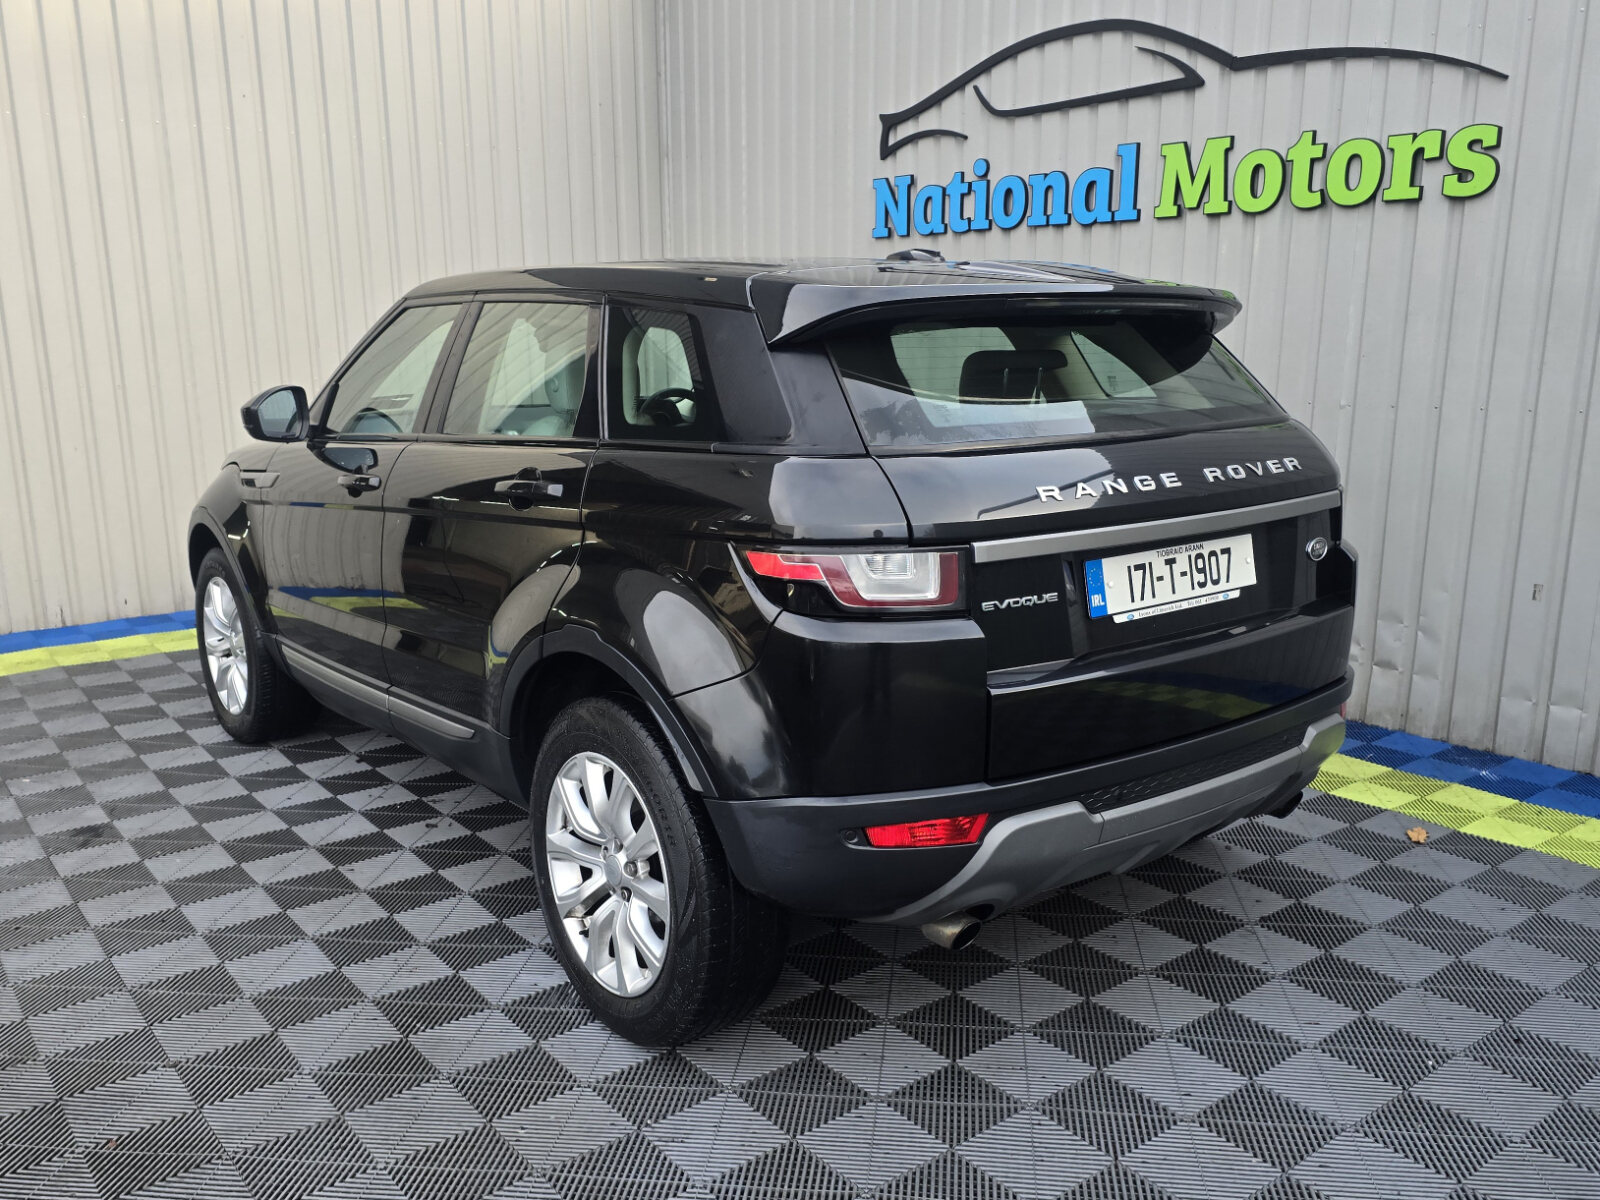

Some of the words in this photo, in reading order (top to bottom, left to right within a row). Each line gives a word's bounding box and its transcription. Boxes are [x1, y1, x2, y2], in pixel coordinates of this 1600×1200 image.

[871, 141, 1142, 239] National
[1153, 123, 1502, 219] Motors
[1035, 471, 1183, 503] RANGE
[1203, 456, 1304, 484] ROVER
[1184, 543, 1205, 553] ARANN
[1126, 547, 1232, 603] 171-T-1907
[981, 591, 1059, 612] EVOQUE
[1091, 594, 1105, 608] IRL
